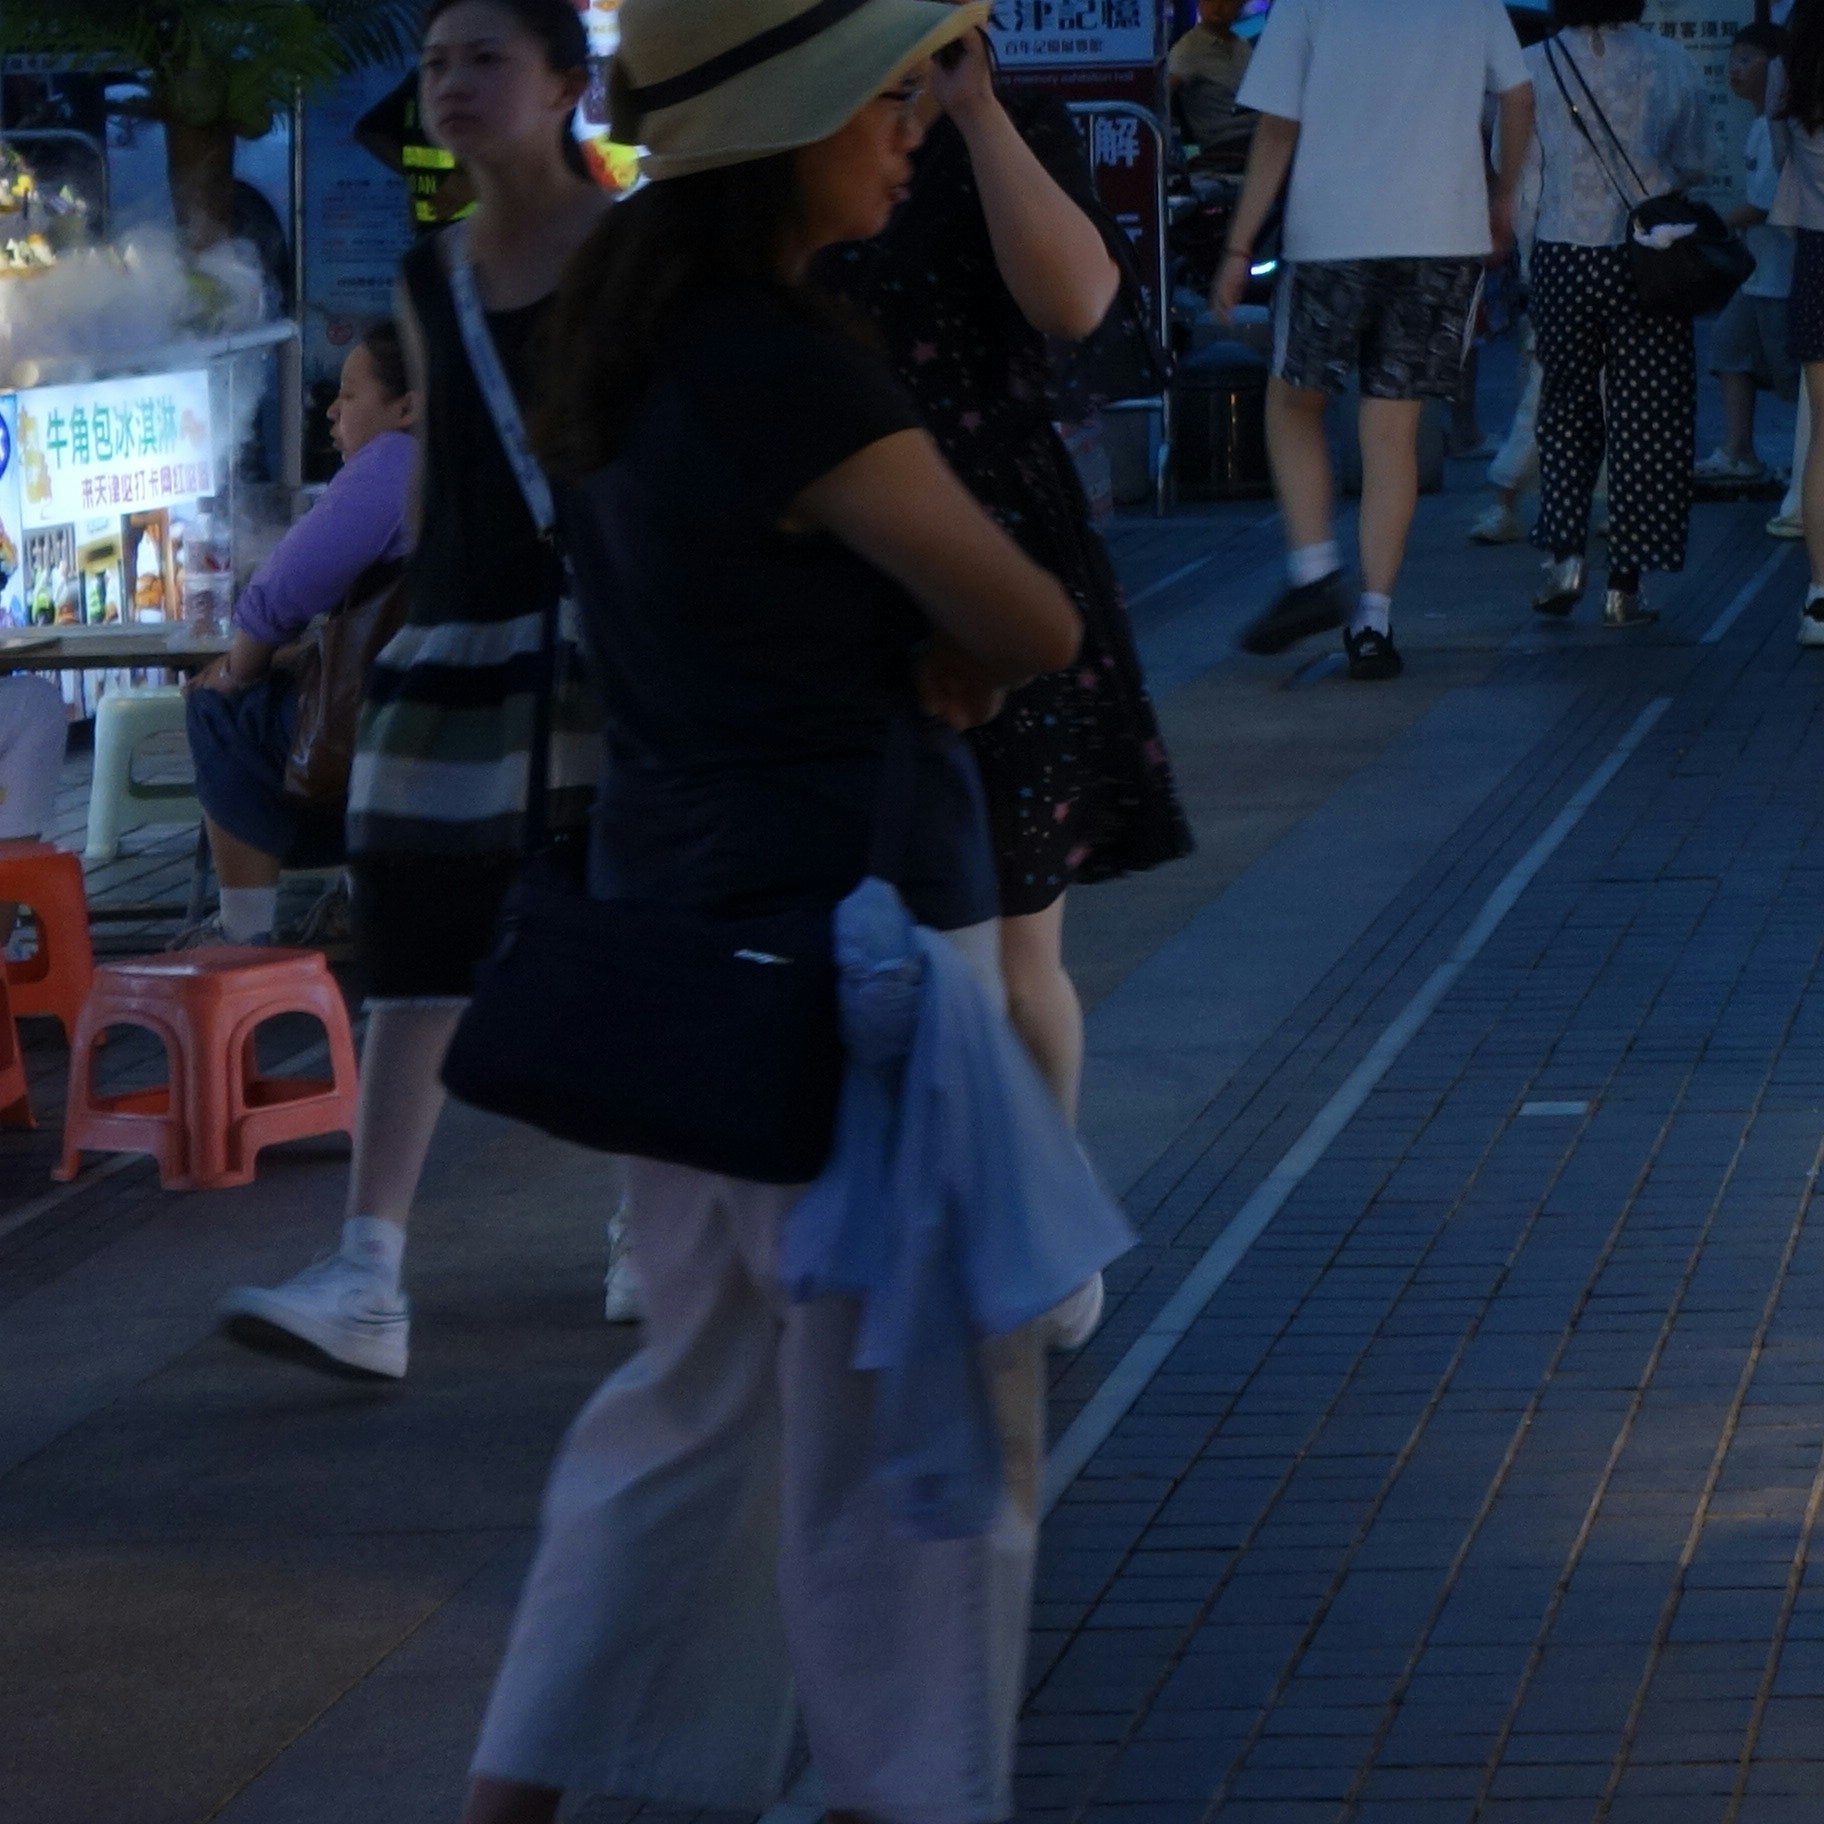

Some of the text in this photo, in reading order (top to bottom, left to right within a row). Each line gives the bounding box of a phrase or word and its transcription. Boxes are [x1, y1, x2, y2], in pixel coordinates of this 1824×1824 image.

[47, 394, 179, 469] 牛角包冰淇淋
